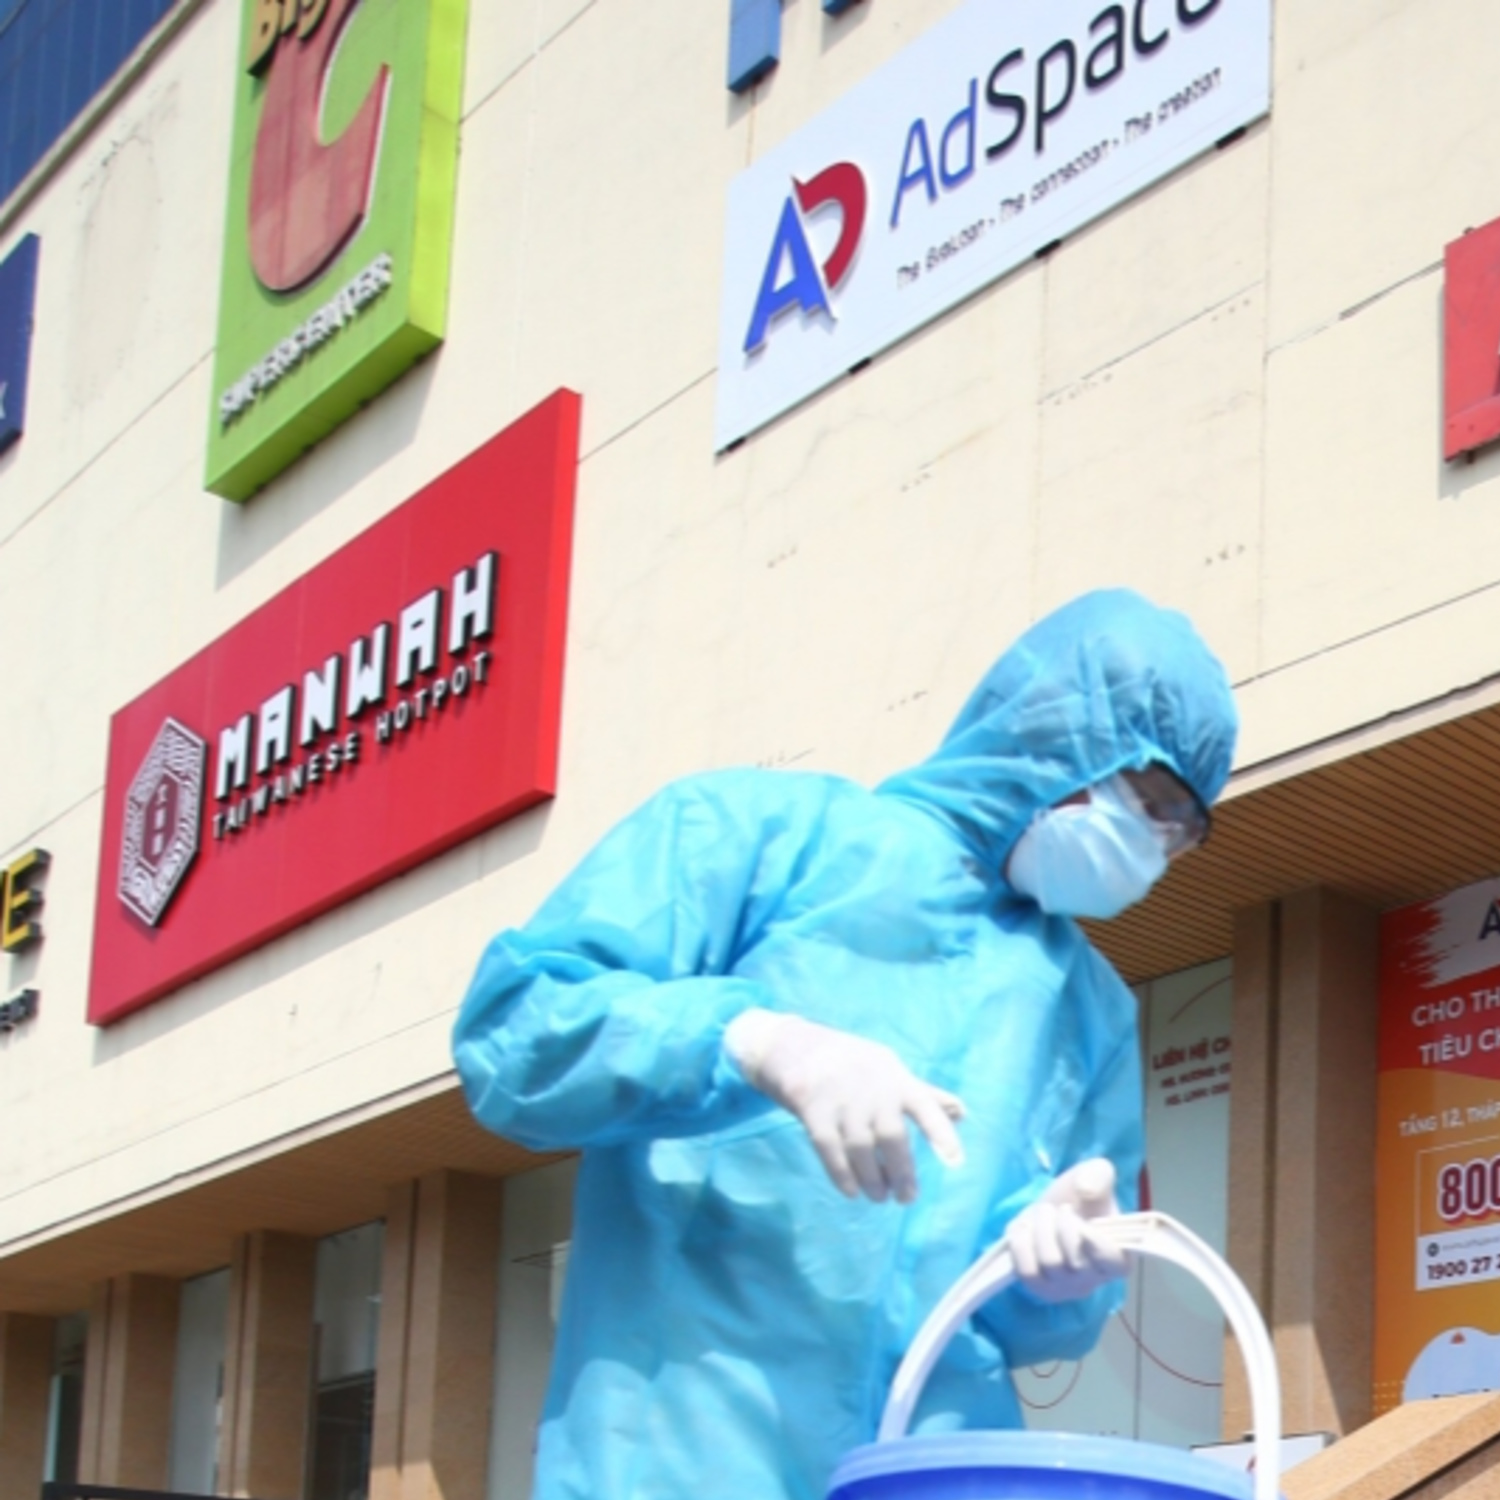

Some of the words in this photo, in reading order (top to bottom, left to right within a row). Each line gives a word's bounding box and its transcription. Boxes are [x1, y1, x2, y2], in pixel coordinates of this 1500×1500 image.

[214, 550, 499, 802] MANWAH
[213, 731, 361, 841] TAIWANESE
[375, 650, 490, 744] HOTPOT
[1411, 997, 1466, 1027] CHO
[1418, 1033, 1472, 1066] TIÊU
[1427, 1260, 1468, 1281] 1900
[1470, 1255, 1492, 1275] 27
